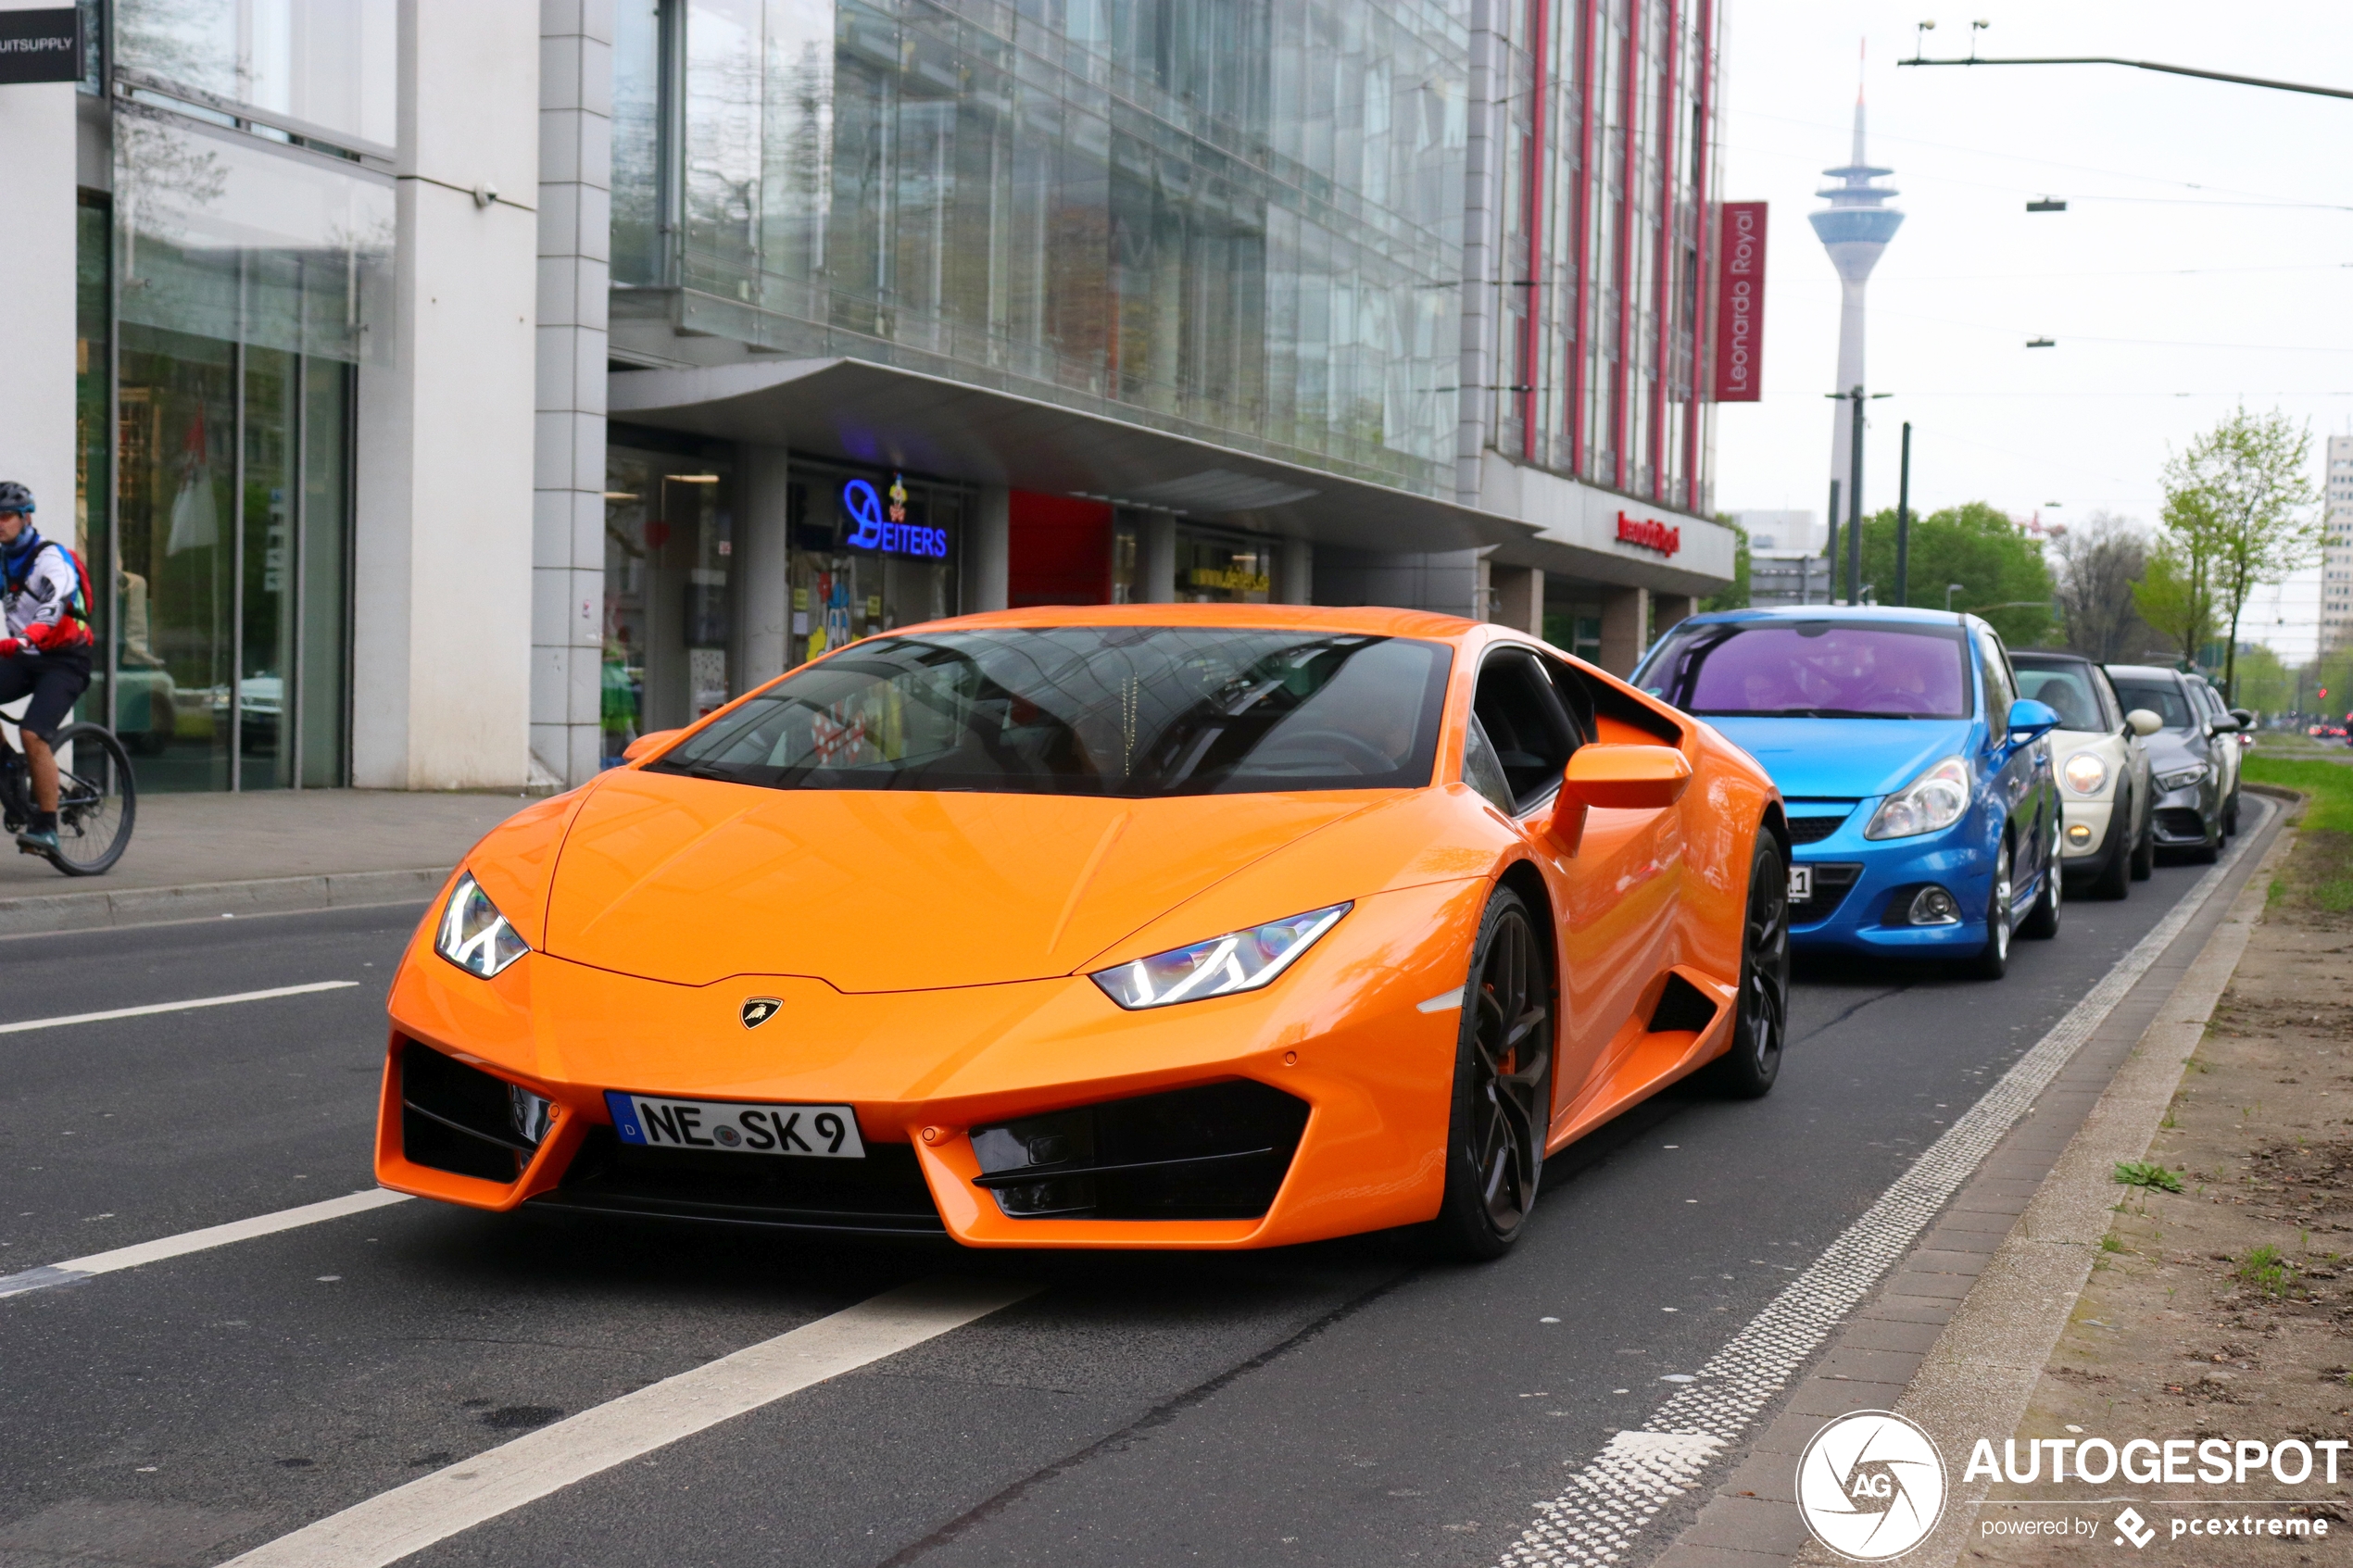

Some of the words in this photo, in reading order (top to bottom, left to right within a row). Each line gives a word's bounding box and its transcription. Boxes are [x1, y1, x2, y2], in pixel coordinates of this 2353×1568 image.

[0, 37, 73, 54] UITSUPPLY
[1730, 210, 1755, 274] Royal
[1728, 281, 1750, 392] Leonardo
[623, 1123, 635, 1136] D
[640, 1102, 714, 1147] NE
[739, 1110, 812, 1152] SK
[814, 1112, 846, 1153] 9
